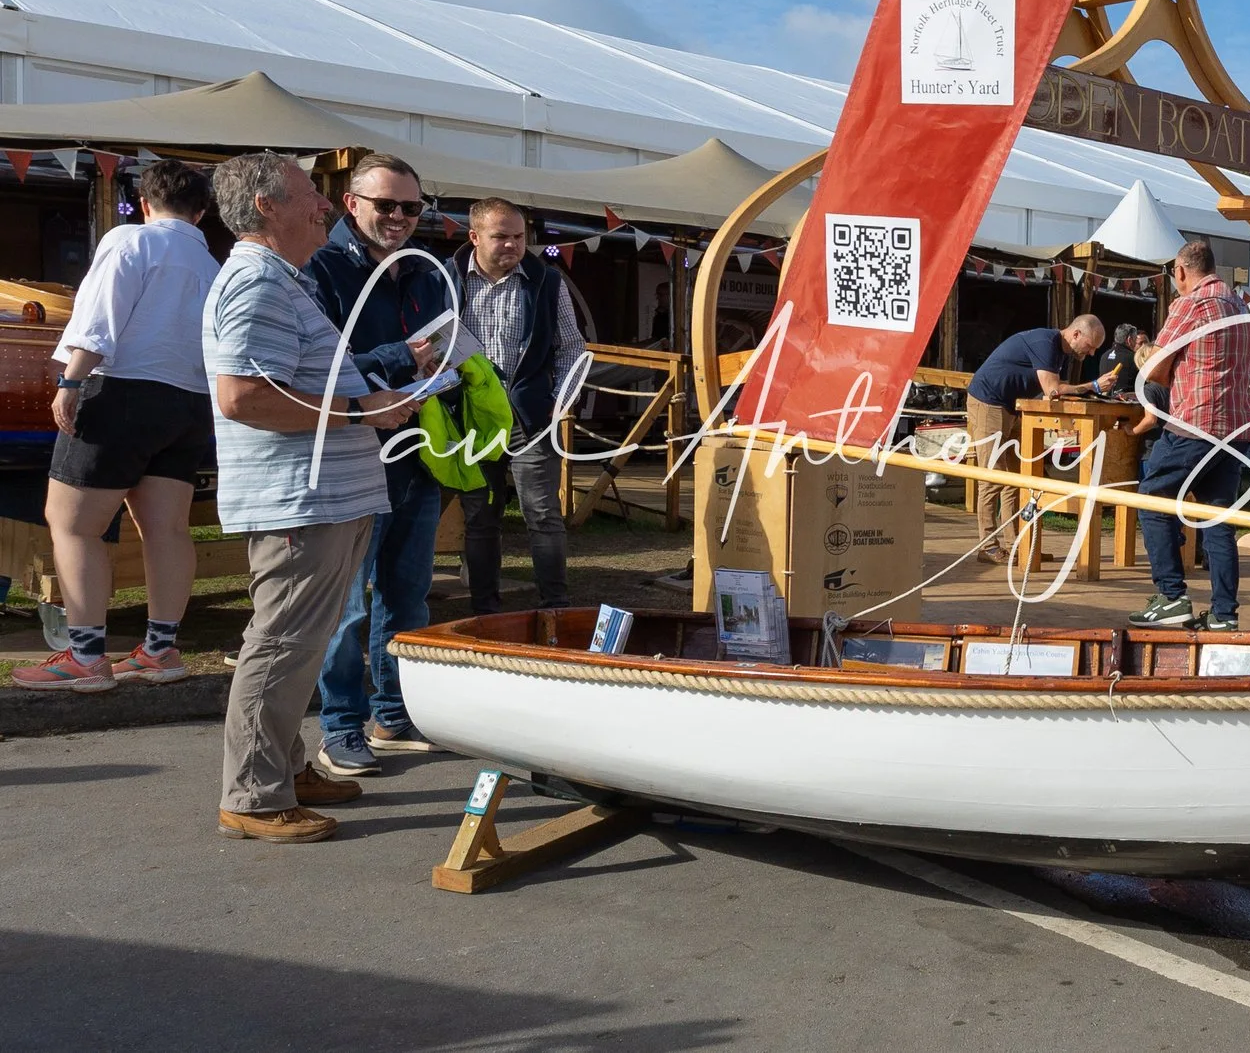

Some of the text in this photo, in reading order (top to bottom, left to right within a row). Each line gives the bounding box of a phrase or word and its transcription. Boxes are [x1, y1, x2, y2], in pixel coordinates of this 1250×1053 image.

[909, 13, 930, 55] Norfolk
[974, 0, 997, 25] Fleet
[994, 25, 1005, 57] Trust
[911, 79, 1000, 95] Hunter's Yard
[1024, 69, 1144, 142] ODEN
[729, 280, 754, 294] BOAT
[827, 471, 849, 482] wbta
[857, 499, 894, 508] Association
[853, 529, 884, 538] WOMEN IN
[853, 538, 868, 546] BOAT
[868, 536, 894, 545] BUILDING
[827, 589, 893, 599] Boat Building Academy
[972, 647, 990, 655] Cabin
